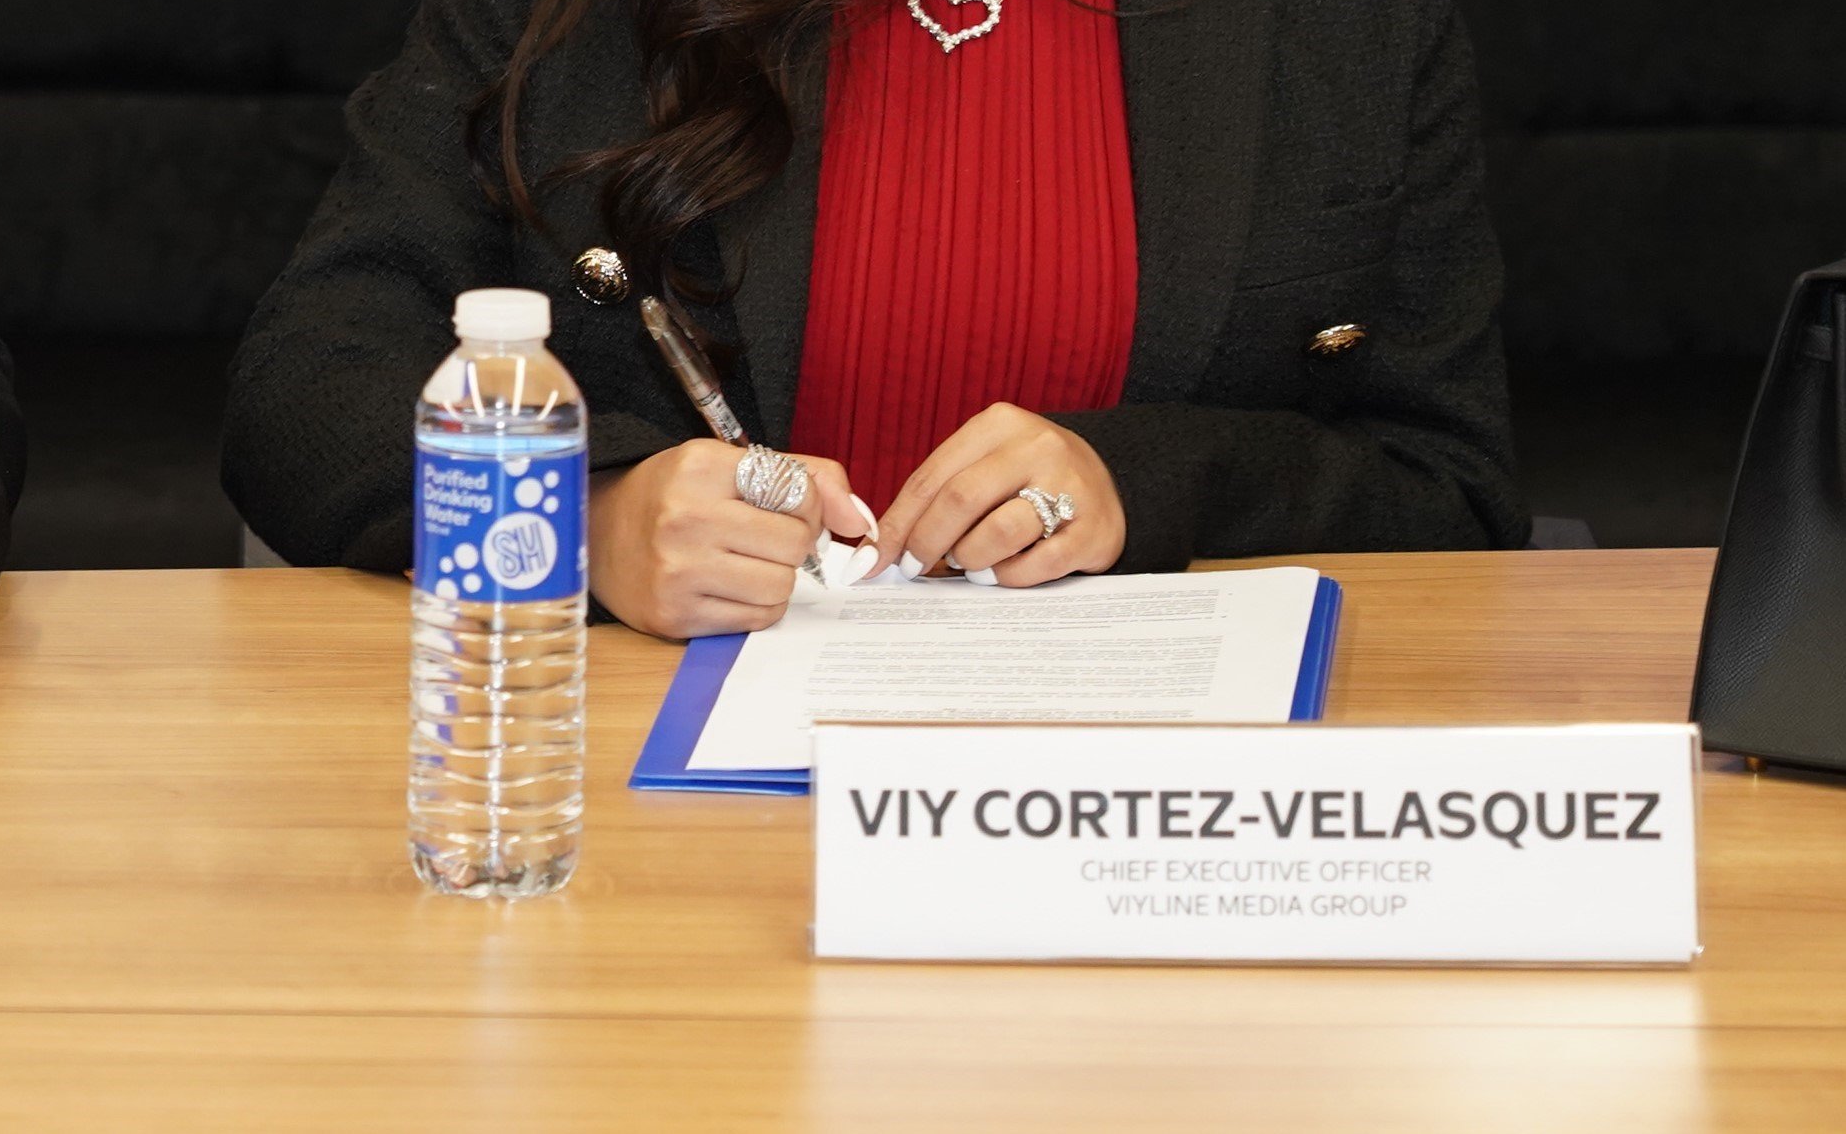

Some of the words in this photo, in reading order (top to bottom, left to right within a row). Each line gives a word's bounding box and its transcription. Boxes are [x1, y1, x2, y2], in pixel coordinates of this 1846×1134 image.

[423, 463, 489, 491] Purified
[423, 482, 493, 514] Drinking
[424, 503, 472, 527] Water
[848, 789, 958, 838] VIY
[973, 789, 1662, 850] CORTEZ-VELASQUEZ
[1081, 860, 1157, 882] CHIEF
[1166, 859, 1310, 883] EXECUTIVE
[1319, 860, 1432, 883] OFFICER
[1106, 894, 1209, 917] VIYLINE
[1218, 894, 1303, 917] MEDIA
[1310, 894, 1408, 917] GROUP
